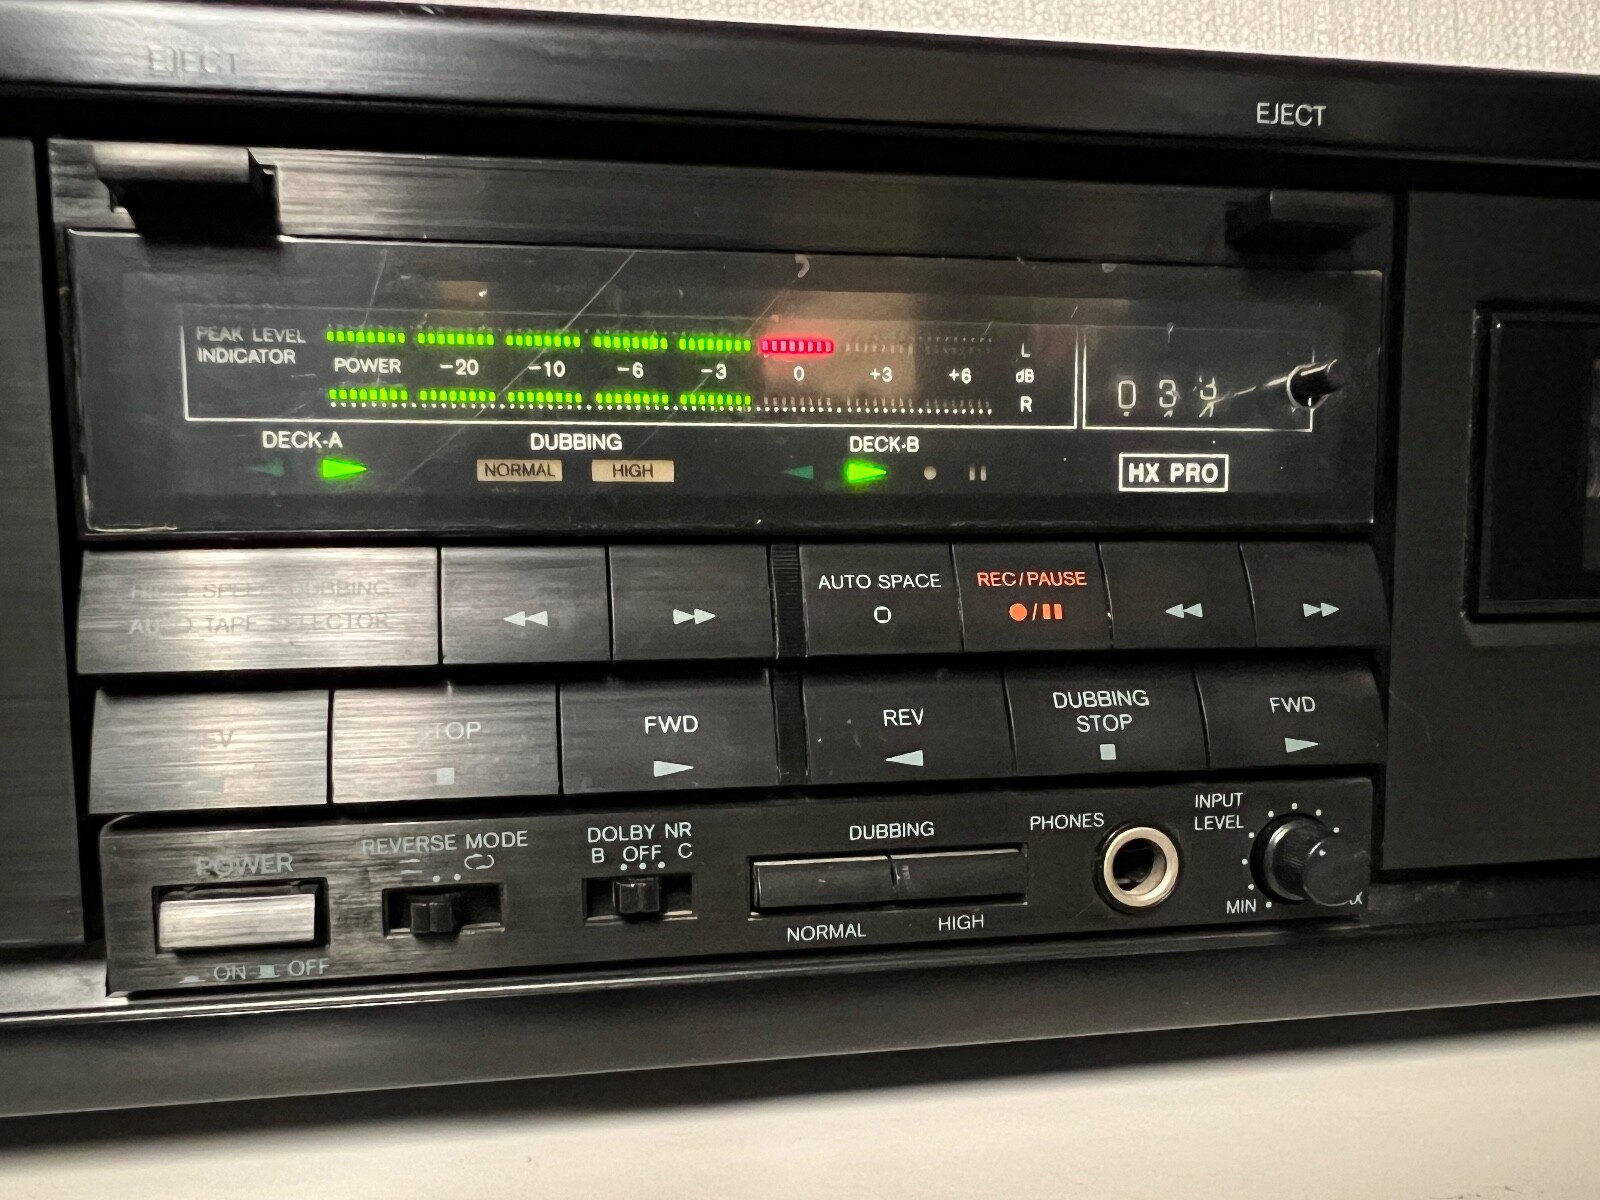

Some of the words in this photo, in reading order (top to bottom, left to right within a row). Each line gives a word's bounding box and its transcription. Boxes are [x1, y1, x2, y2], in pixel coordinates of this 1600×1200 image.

[1256, 102, 1327, 127] EJECT
[196, 326, 244, 342] PEAK
[252, 327, 307, 343] LEVEL
[196, 347, 297, 365] INDICATOR
[1020, 343, 1031, 358] L
[334, 357, 402, 374] POWER
[440, 359, 479, 376] -20
[527, 361, 566, 378] -10
[617, 361, 644, 379] -6
[700, 363, 727, 380] -3
[793, 366, 805, 382] 0
[869, 366, 893, 383] +3
[948, 367, 972, 384] +6
[1015, 368, 1035, 384] dB
[1020, 396, 1033, 413] R
[262, 431, 344, 449] DECK-A
[530, 432, 623, 451] DUBBING
[849, 435, 920, 453] DECK-B
[484, 462, 556, 478] NORMAL
[612, 463, 654, 478] HIGH
[1128, 462, 1160, 483] HX
[1169, 462, 1219, 484] PRO
[818, 574, 872, 590] AUTO
[878, 573, 942, 589] SPACE
[976, 571, 1088, 587] REC/PAUSE
[205, 613, 257, 633] TAPE
[1052, 689, 1150, 709] DUBBING
[1269, 696, 1316, 713] FWD
[644, 714, 699, 735] FWD
[883, 708, 924, 727] REV
[1076, 713, 1133, 733] STOP
[1195, 792, 1244, 808] INPUT
[849, 820, 935, 841] DUBBING
[1029, 812, 1105, 831] PHONES
[1194, 814, 1245, 831] LEVEL
[587, 824, 656, 843] DOLBY
[664, 821, 692, 839] NR
[362, 834, 457, 855] REVERSE
[465, 830, 529, 850] MODE
[591, 847, 605, 864] B
[622, 844, 662, 862] OFF
[677, 842, 693, 859] C
[195, 852, 295, 876] POWER
[1226, 898, 1257, 914] MIN
[938, 914, 984, 931] HIGH
[787, 922, 867, 943] NORMAL
[213, 963, 247, 981] ON
[287, 958, 330, 977] OFF
